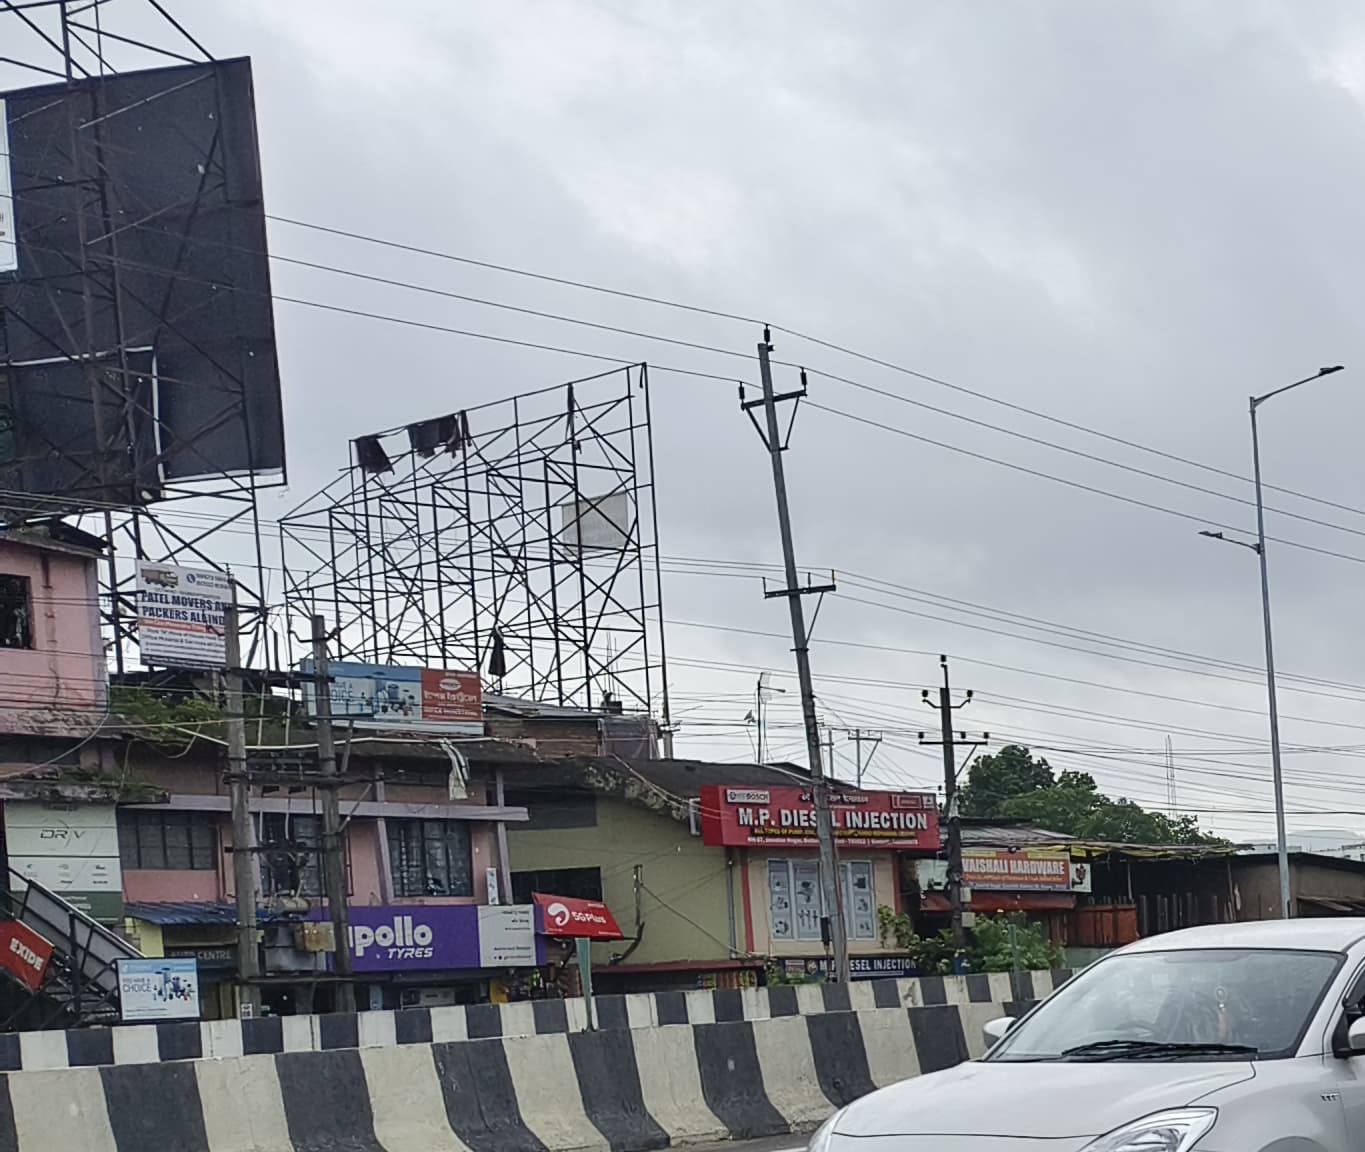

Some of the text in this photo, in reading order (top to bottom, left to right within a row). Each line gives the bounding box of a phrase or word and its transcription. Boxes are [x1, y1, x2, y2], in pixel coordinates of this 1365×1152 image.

[141, 591, 171, 605] PATEL
[171, 595, 212, 612] MOVERS
[142, 606, 189, 622] PACKERS
[738, 807, 928, 830] M.P. DIESL INJECTION
[961, 858, 1065, 875] VAISHALI HARDWARE
[9, 937, 45, 971] EXIDE
[387, 948, 434, 960] TYRES
[850, 960, 871, 971] ESEL
[873, 958, 917, 971] INJECTION
